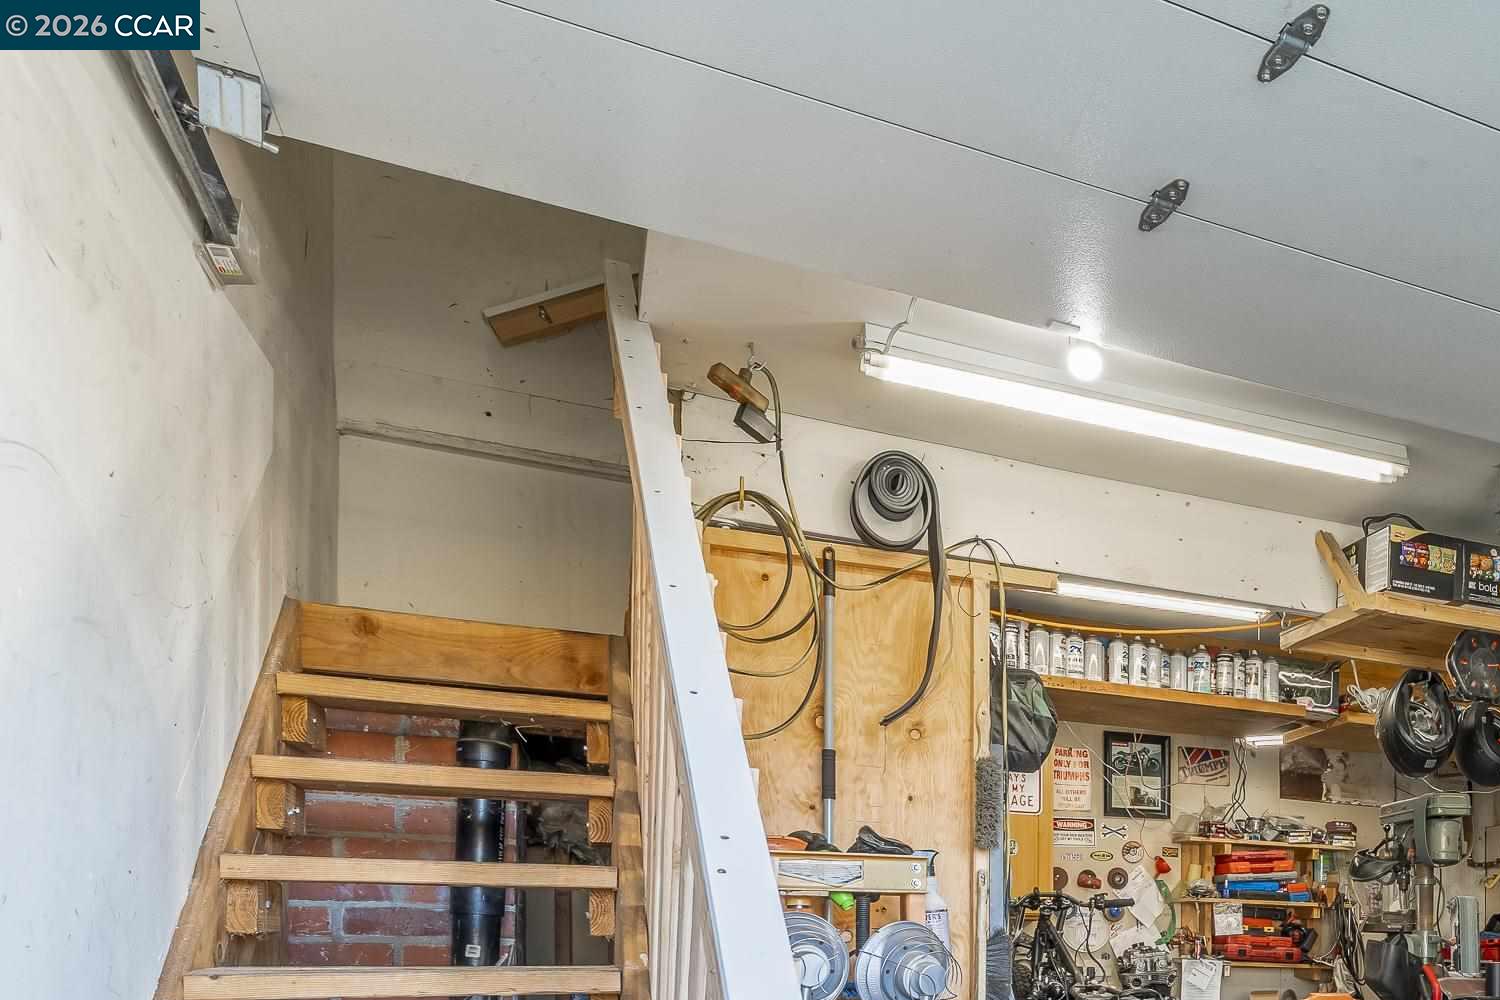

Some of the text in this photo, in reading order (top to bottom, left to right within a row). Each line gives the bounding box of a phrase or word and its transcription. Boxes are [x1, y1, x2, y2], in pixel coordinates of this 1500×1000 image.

[1478, 582, 1498, 593] bold
[1053, 759, 1071, 767] ONLY
[1053, 770, 1089, 781] TRIUMPHS
[1011, 795, 1033, 807] AGE
